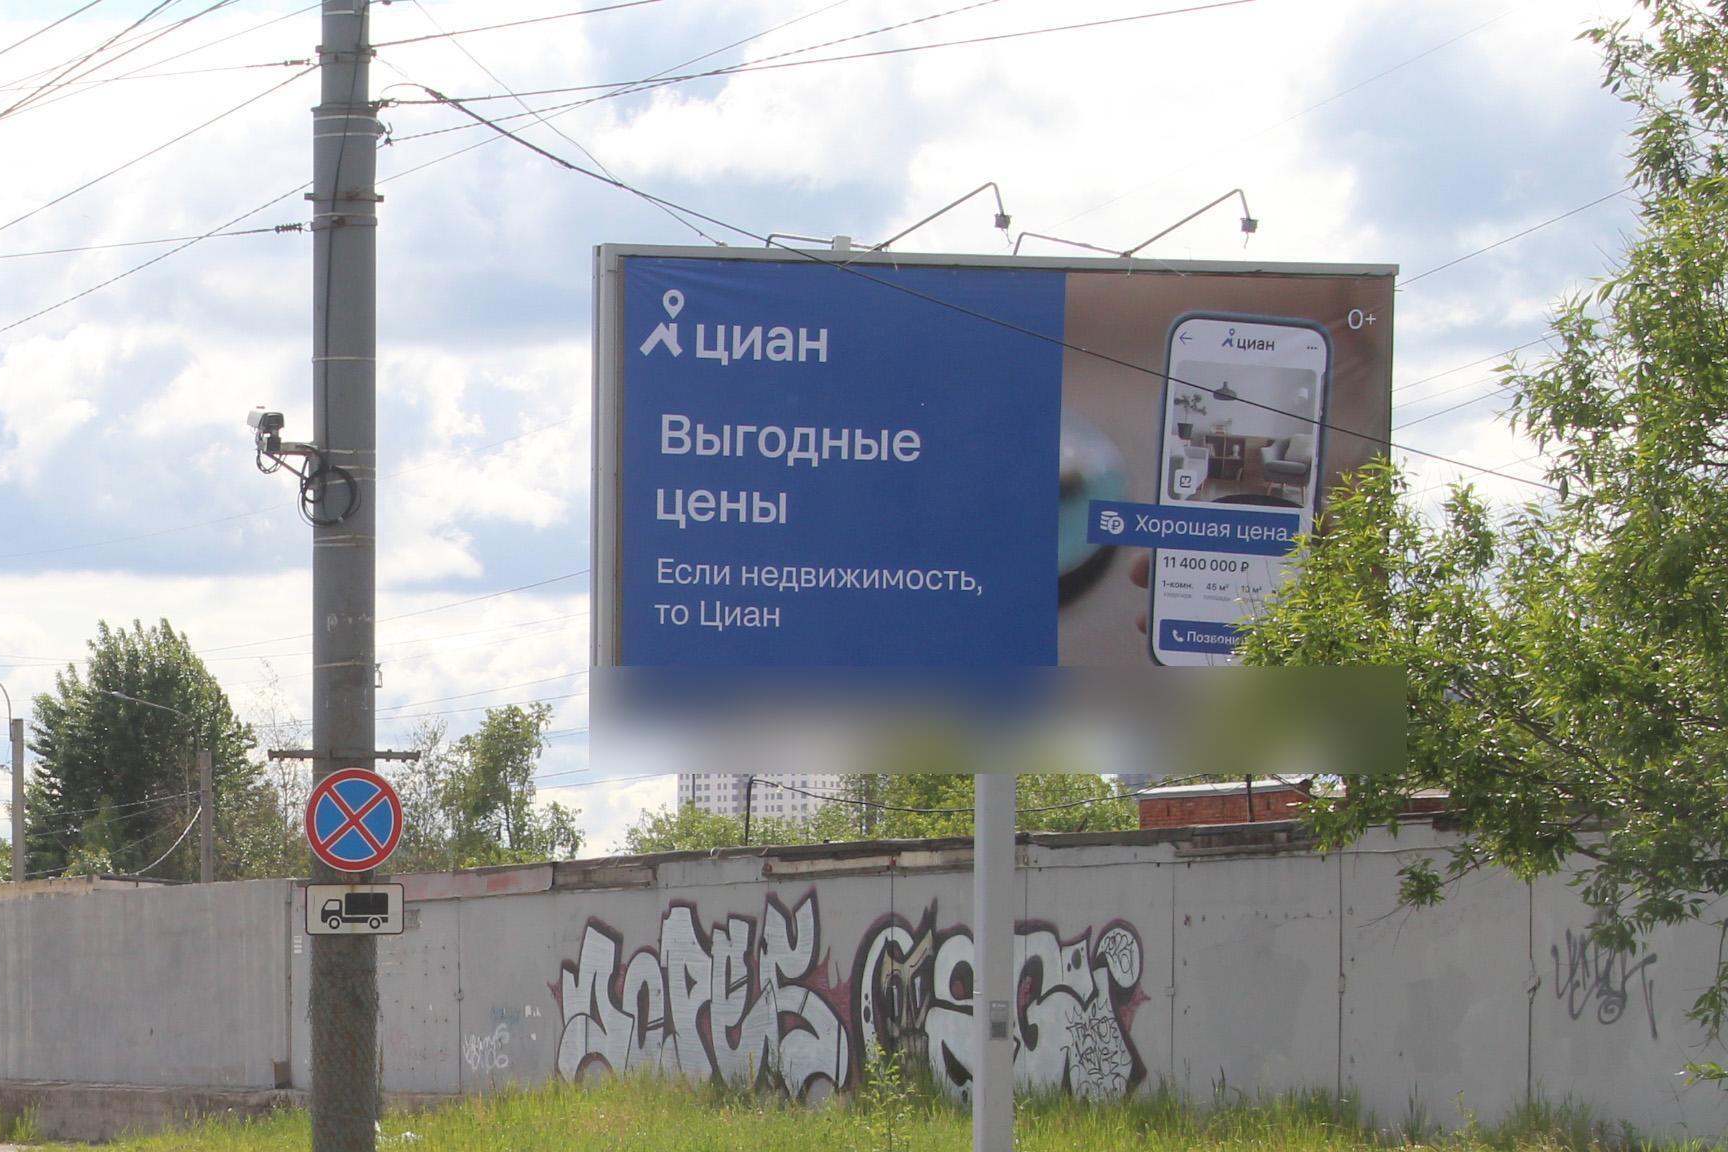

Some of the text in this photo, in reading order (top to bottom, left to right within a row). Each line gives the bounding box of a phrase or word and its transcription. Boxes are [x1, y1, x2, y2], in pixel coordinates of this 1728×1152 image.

[1347, 309, 1377, 330] 0+
[695, 324, 828, 365] циан
[1236, 336, 1275, 351] циан
[660, 414, 921, 467] Выгодные
[656, 488, 787, 529] цены
[1135, 514, 1288, 541] Хорошая цена
[657, 558, 984, 595] Если недвижимость,
[1164, 556, 1176, 568] 11
[1180, 558, 1206, 570] 400
[1210, 560, 1237, 572] 000
[655, 601, 780, 631] то Циан
